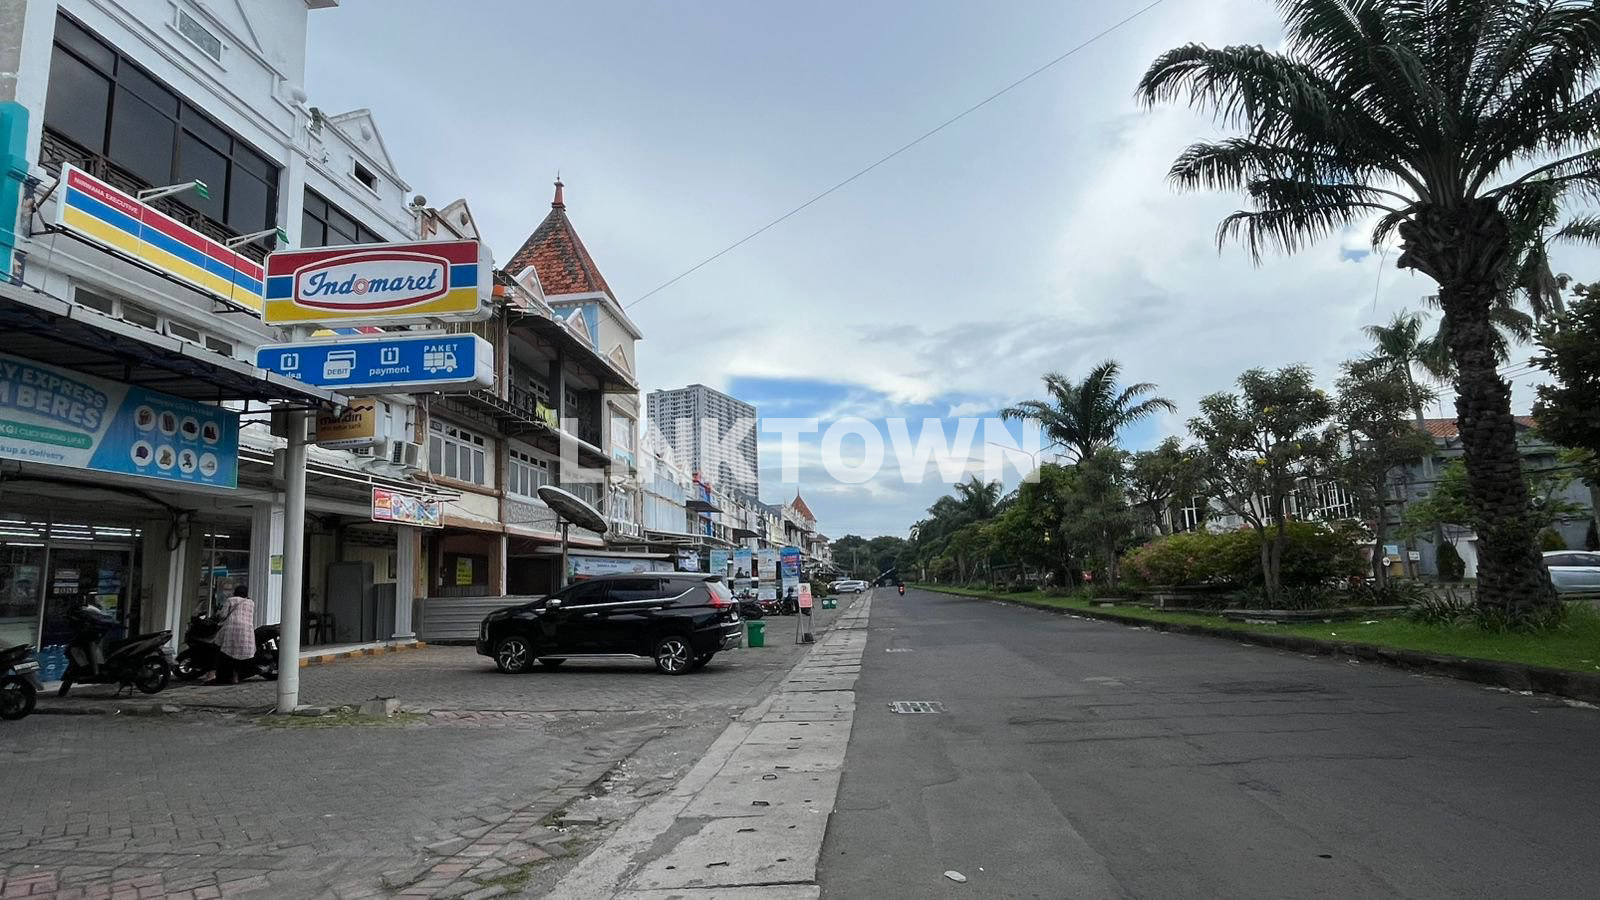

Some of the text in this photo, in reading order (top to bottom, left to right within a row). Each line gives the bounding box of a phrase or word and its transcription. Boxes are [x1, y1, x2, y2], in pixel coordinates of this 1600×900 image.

[105, 192, 139, 214] EXECUTIVE
[302, 268, 437, 297] Indomaret
[423, 343, 458, 352] PAKET
[327, 367, 348, 376] DEBIT
[369, 365, 410, 377] payment
[22, 367, 106, 408] EXPRESS
[17, 384, 98, 429] BERES
[0, 444, 18, 455] kup
[29, 448, 64, 460] Delivery
